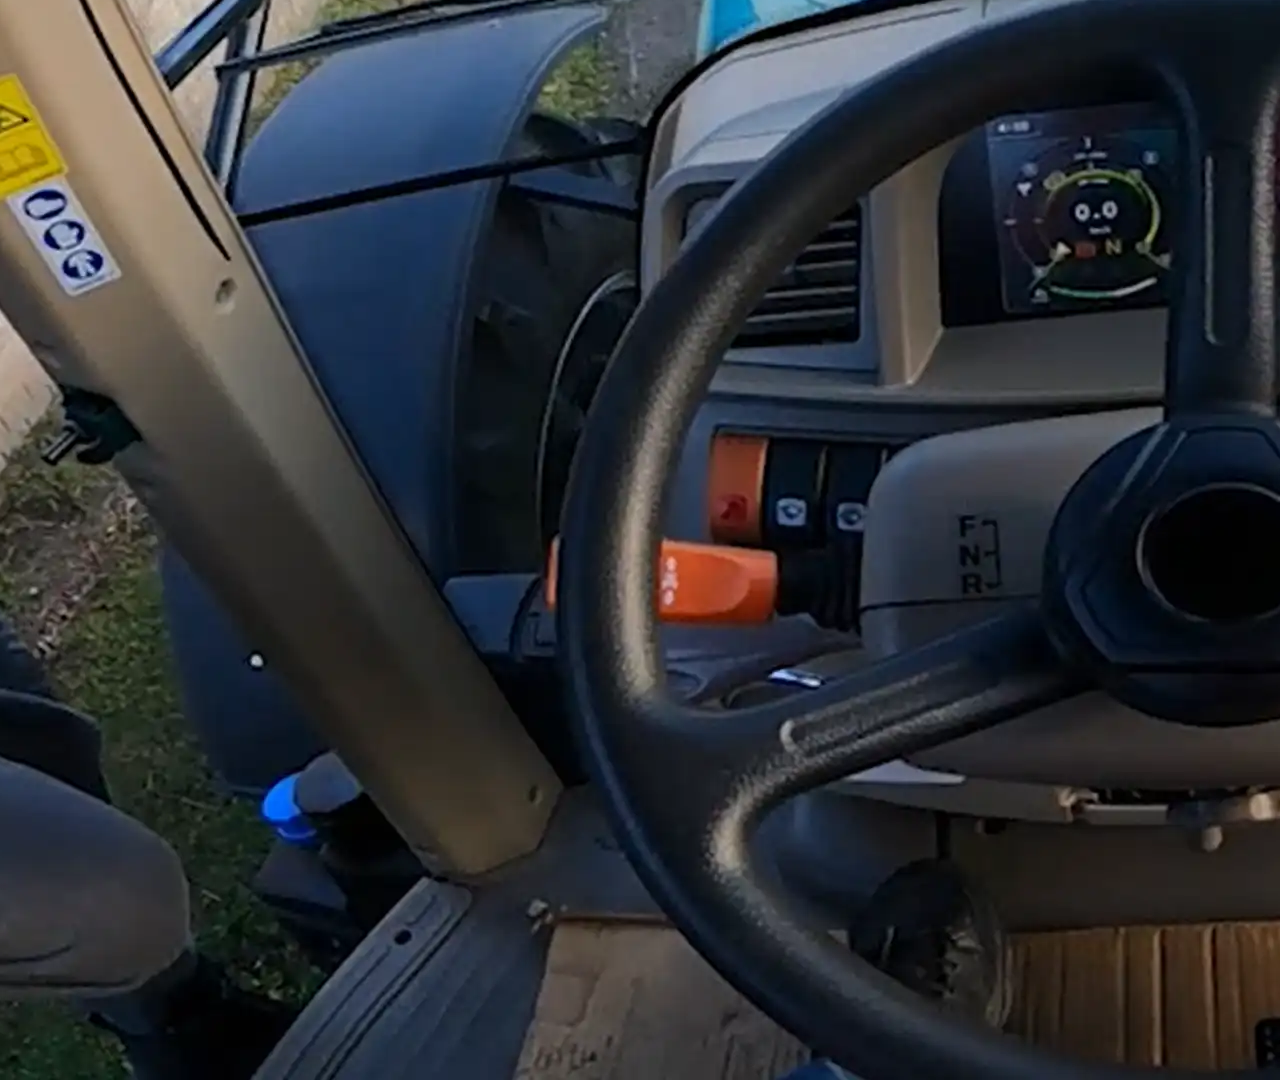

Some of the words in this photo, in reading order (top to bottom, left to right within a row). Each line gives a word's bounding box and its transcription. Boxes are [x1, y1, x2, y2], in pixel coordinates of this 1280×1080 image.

[1075, 200, 1118, 221] 0.0
[1105, 239, 1122, 255] N
[959, 515, 976, 537] F
[959, 543, 979, 566] N
[962, 573, 982, 594] R
